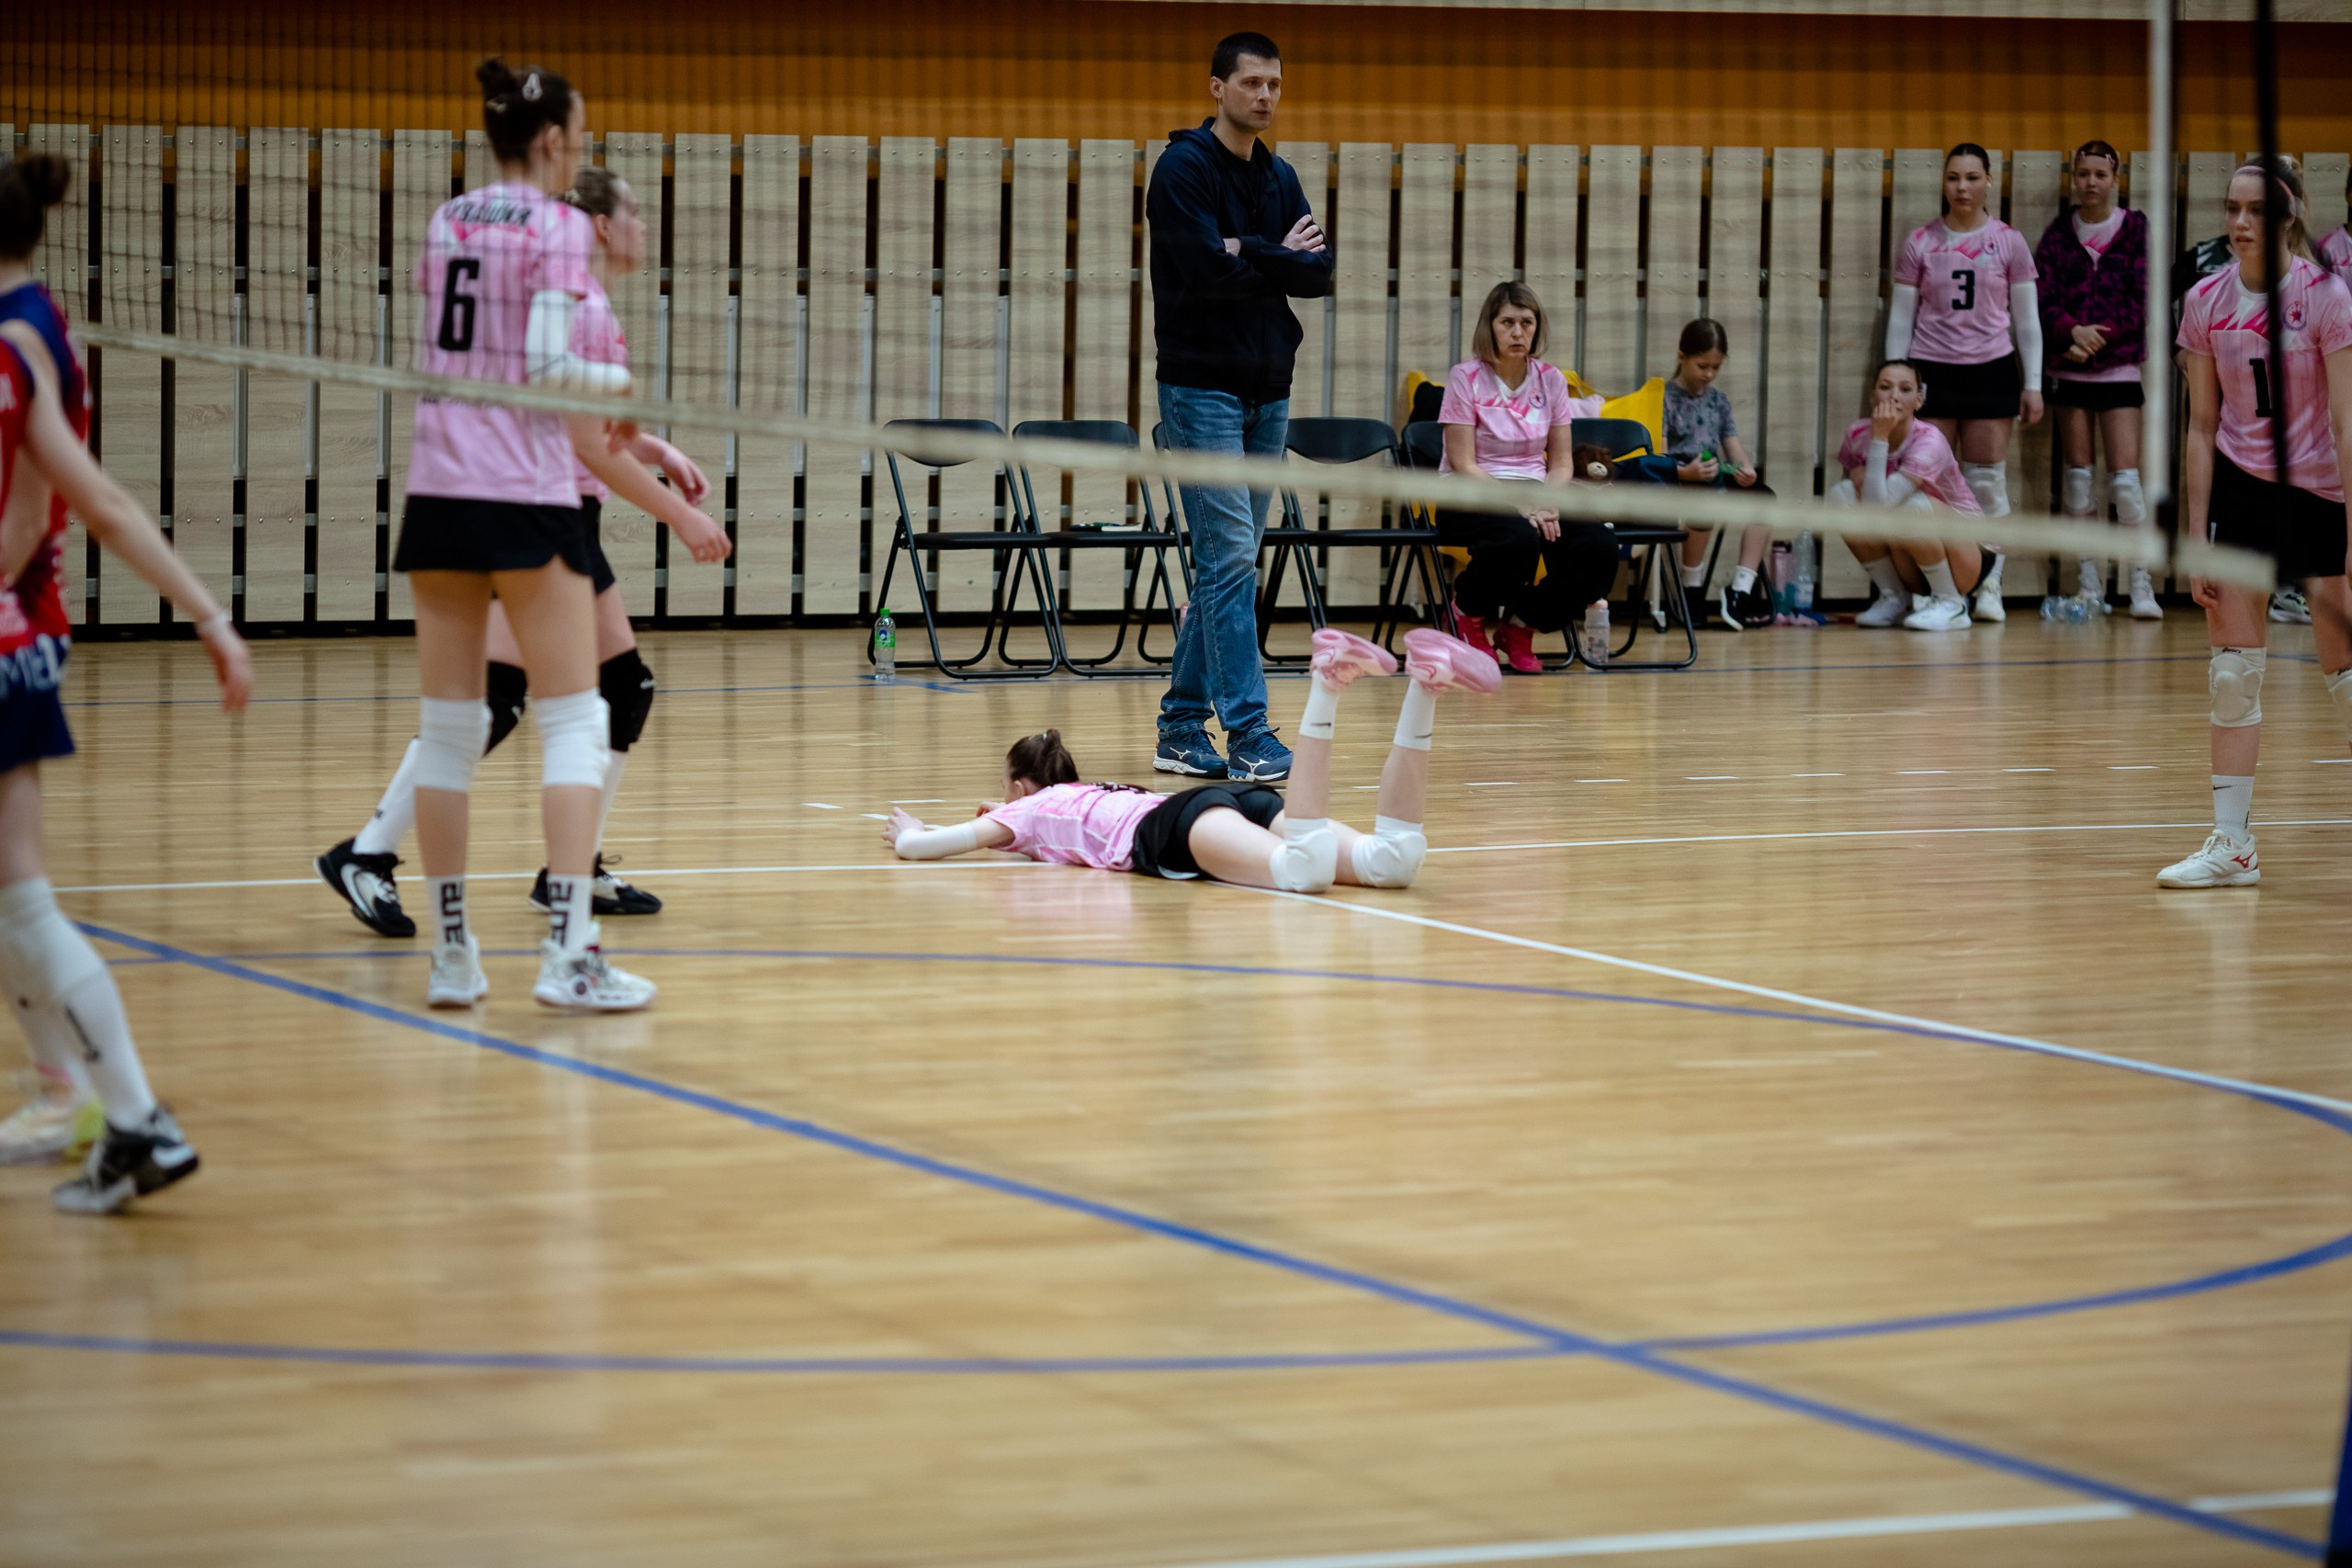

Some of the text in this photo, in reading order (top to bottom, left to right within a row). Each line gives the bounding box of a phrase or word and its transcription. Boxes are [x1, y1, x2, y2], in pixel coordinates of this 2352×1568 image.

[438, 258, 480, 352] 6
[1951, 269, 1975, 310] 3
[2248, 357, 2275, 418] 1
